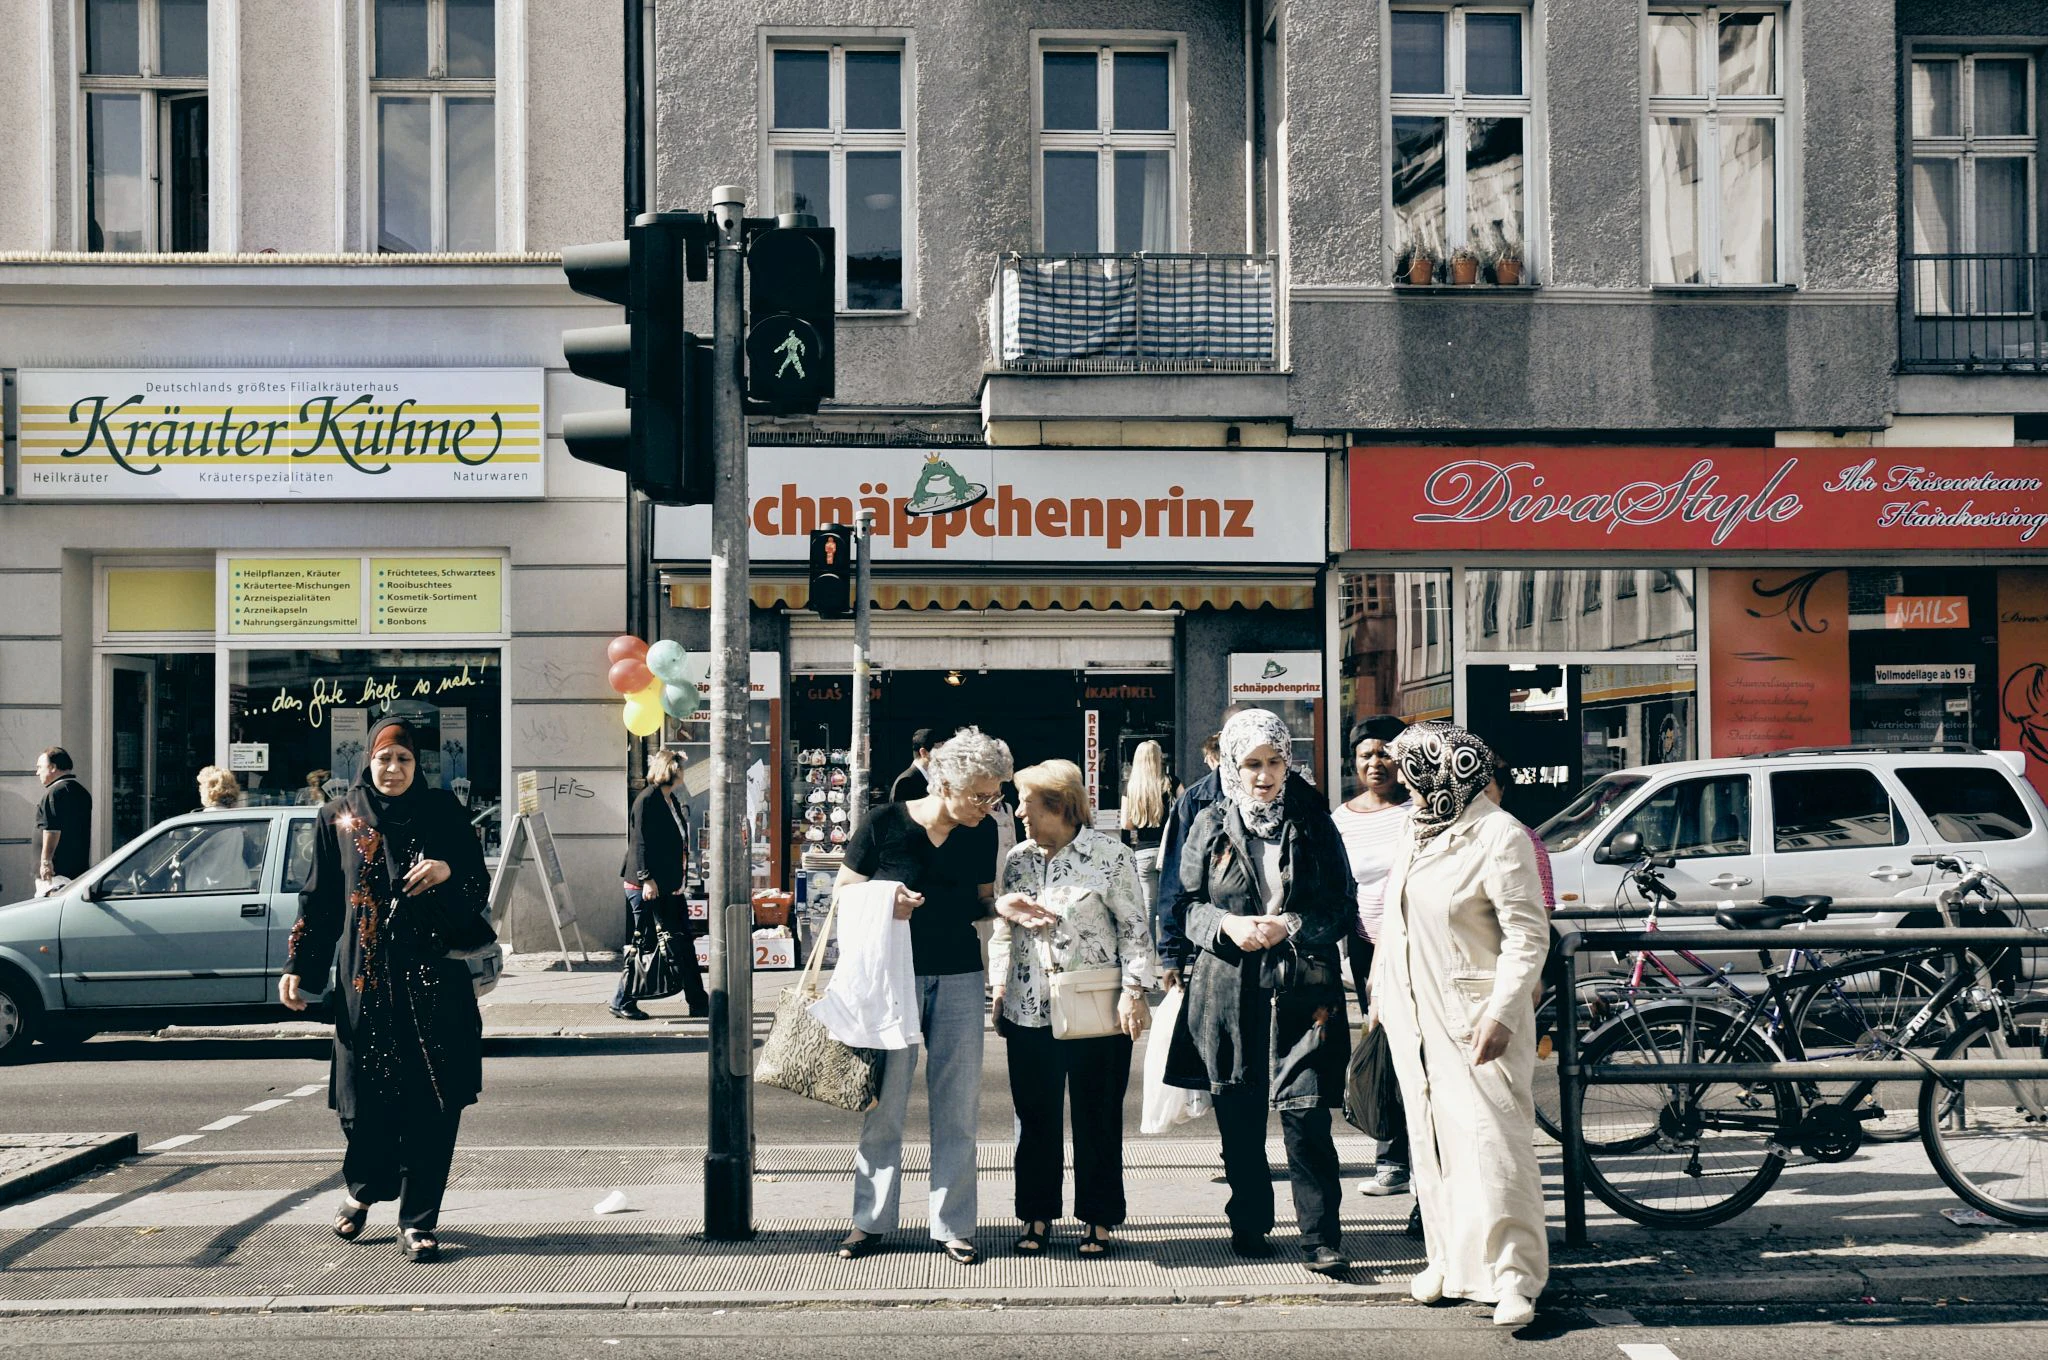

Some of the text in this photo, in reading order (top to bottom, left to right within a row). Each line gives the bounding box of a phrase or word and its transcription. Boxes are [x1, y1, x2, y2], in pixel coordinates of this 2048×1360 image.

[146, 381, 400, 396] Deutschlands größtes Filialkräuterhaus
[60, 393, 503, 476] Kräuter Kühne
[33, 471, 109, 484] Heilkräuter
[199, 471, 334, 485] Kräuterspezialitäten
[453, 469, 529, 483] Naturwaren
[1823, 458, 2043, 493] Ihr Friseurteam
[748, 483, 1254, 549] chnäppchenprinz
[1877, 500, 2048, 542] Hairdressing
[307, 569, 341, 578] Kräuter
[387, 568, 496, 578] Früchtetees, Schwarztees
[243, 582, 350, 591] Kräutertee-Mischungen
[387, 581, 452, 589] Rooibuschtees
[243, 594, 331, 603] Arzneispezialitäten
[387, 593, 478, 601] Kosmetik-Sortiment
[243, 606, 308, 615] Arzneikapseln
[387, 605, 428, 614] Gewürze
[1894, 600, 1963, 625] NAILS
[243, 618, 358, 628] Nahrungsergänzungsmittel
[387, 617, 427, 626] Bonbons
[1876, 670, 1938, 682] Vollmodellage
[1941, 669, 1951, 680] ab
[1954, 668, 1966, 680] 19
[1233, 682, 1321, 694] schnäppchenprinz
